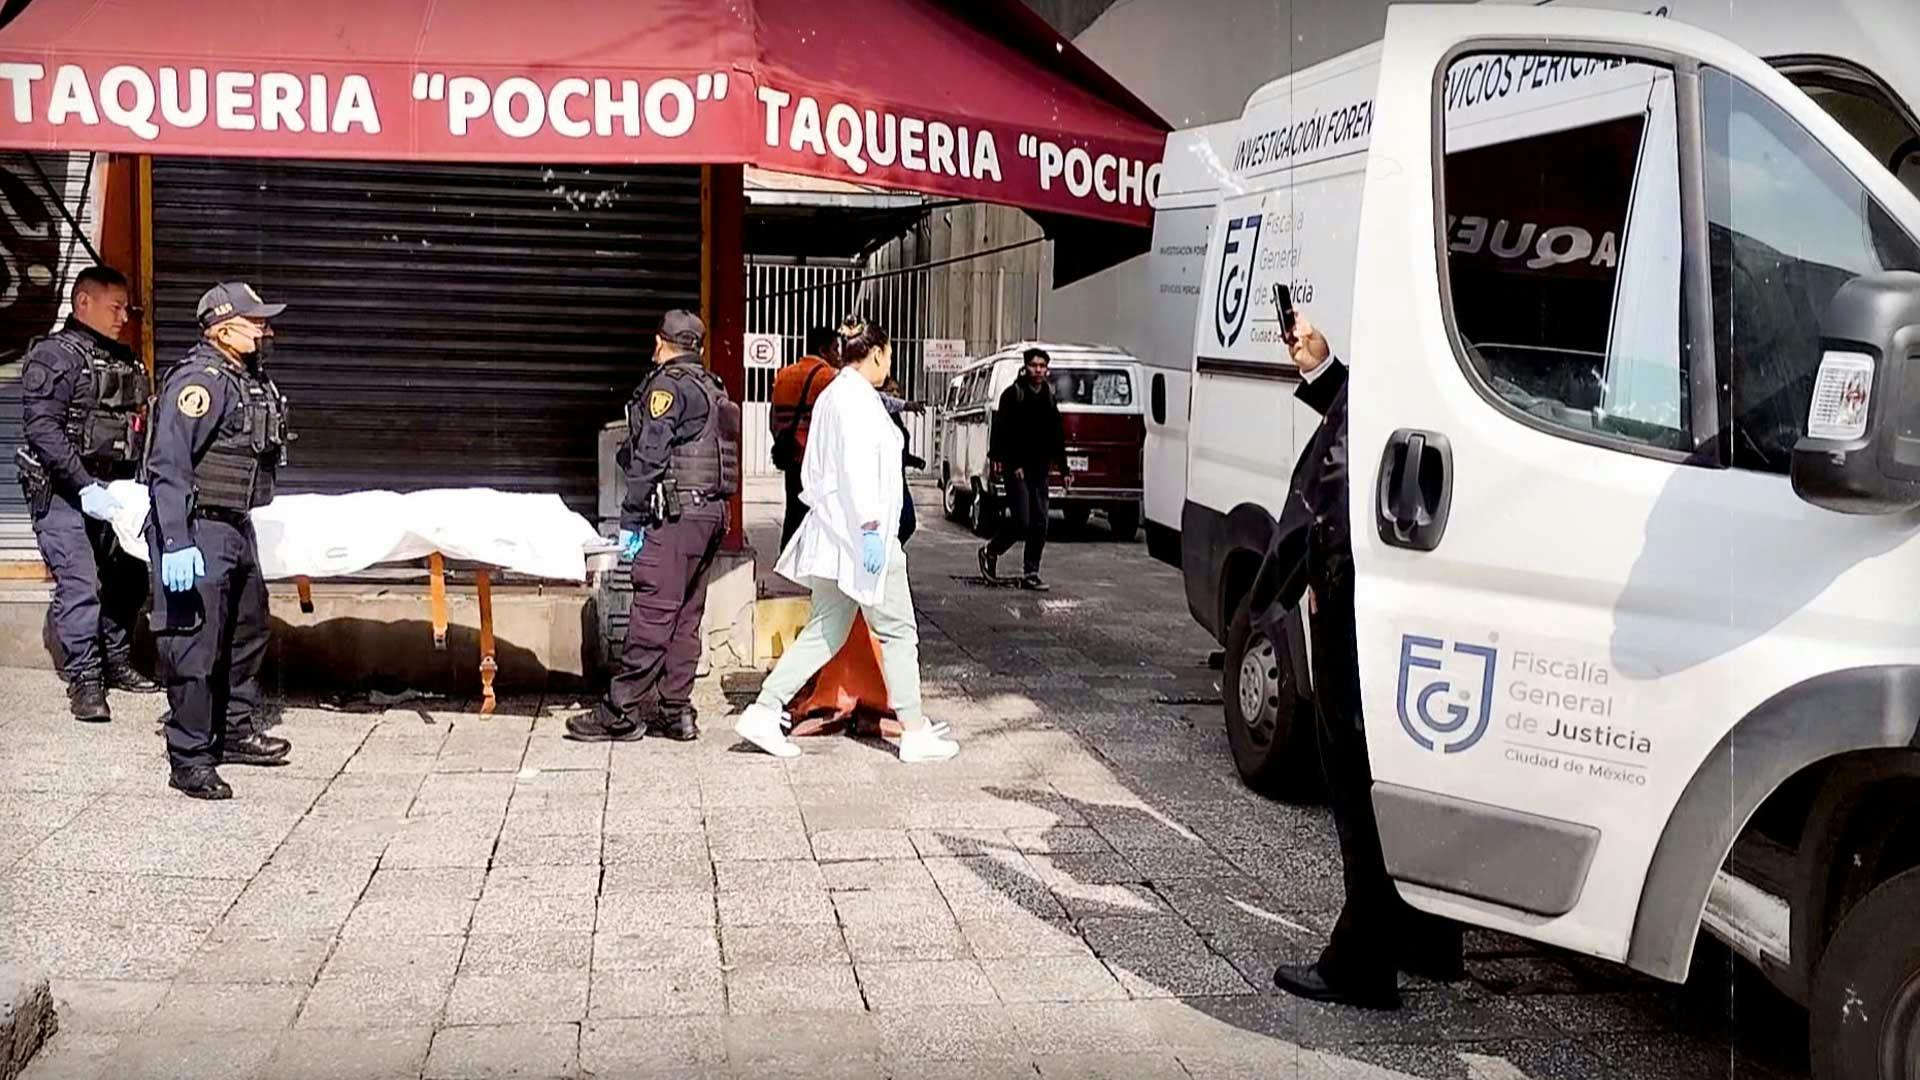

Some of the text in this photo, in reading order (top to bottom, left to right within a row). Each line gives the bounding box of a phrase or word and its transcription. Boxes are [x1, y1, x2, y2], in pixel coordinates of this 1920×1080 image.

[0, 62, 730, 140] TAQUERIA "POCHO"
[1444, 55, 1516, 111] VICIOS
[757, 86, 1002, 175] TAQUERIA
[1233, 107, 1327, 172] INVESTIGACIÓN
[1265, 211, 1304, 234] Fiscaa
[1259, 247, 1302, 271] General
[1254, 284, 1268, 306] de
[755, 344, 770, 360] E
[1512, 650, 1609, 686] Fiscalía
[1509, 680, 1613, 718] General
[1505, 712, 1652, 754] de Justicia
[1504, 748, 1647, 787] Ciudad de México
